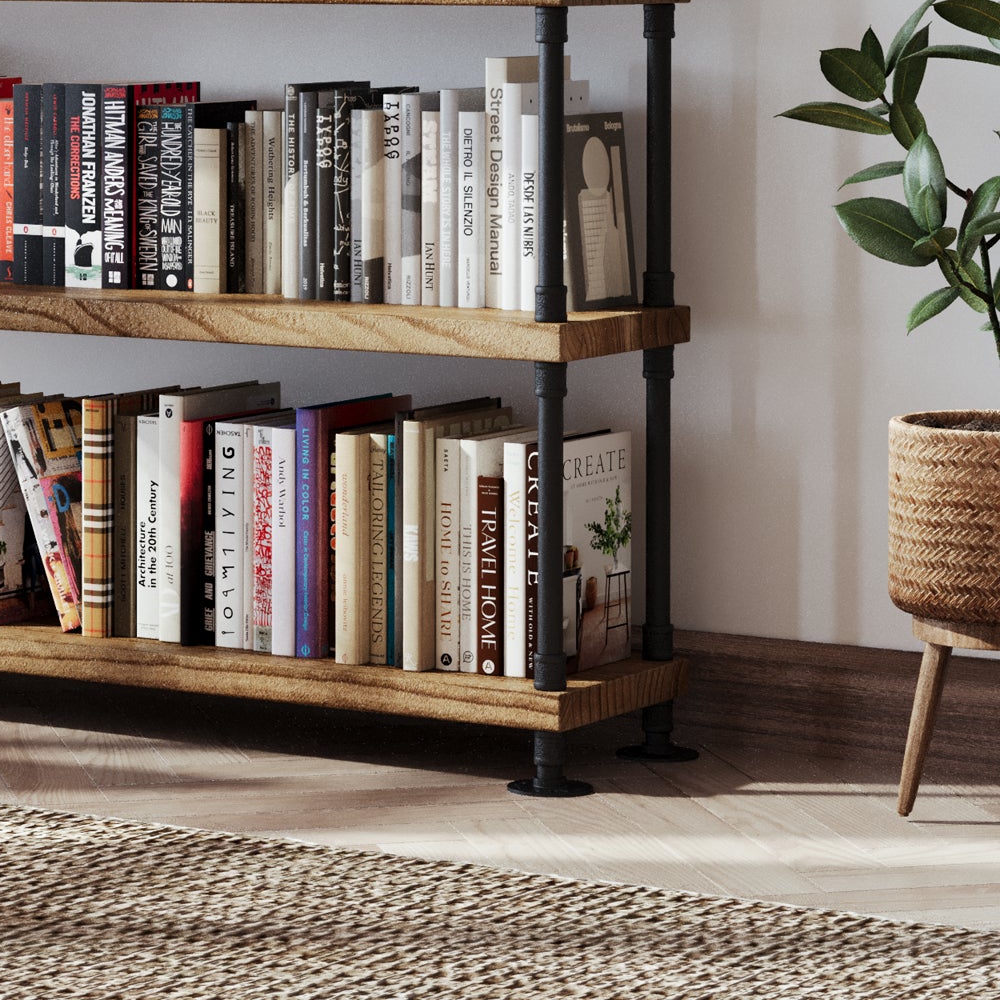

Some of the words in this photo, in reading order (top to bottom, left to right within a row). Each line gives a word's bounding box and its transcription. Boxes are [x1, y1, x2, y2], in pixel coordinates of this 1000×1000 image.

[71, 116, 79, 135] THE
[82, 91, 95, 157] JONATHAN
[104, 100, 124, 148] HITMAN
[490, 88, 503, 142] Street
[463, 128, 472, 167] DIETRO
[71, 137, 80, 200] CORRECTIONS
[105, 151, 124, 195] ANDERS
[139, 156, 157, 189] SAVED
[463, 172, 472, 180] IL
[487, 150, 503, 208] Design
[82, 162, 95, 223] FRANZEN
[139, 199, 158, 223] KING
[463, 185, 472, 236] SILENZIO
[139, 230, 158, 270] SWEDEN
[426, 243, 434, 260] IAN
[490, 215, 503, 275] Manual
[426, 263, 434, 290] HUNT
[278, 457, 286, 485] Andy
[302, 469, 309, 479] IN
[563, 449, 626, 481] CREATE
[149, 480, 158, 523] Century
[278, 490, 286, 528] Warhol
[341, 474, 350, 536] wonderland
[372, 460, 384, 555] TAILORING
[404, 525, 418, 562] KAWS
[440, 501, 451, 554] HOME
[462, 524, 471, 559] THIS
[481, 507, 496, 578] TRAVEL
[205, 530, 214, 575] GRIEVANCE
[440, 560, 451, 575] to
[462, 563, 471, 573] IS
[149, 579, 156, 588] in
[205, 583, 214, 599] AND
[372, 562, 382, 642] LEGENDS
[462, 577, 471, 621] HOME
[205, 608, 214, 631] GRIEF
[440, 581, 451, 642] SHARE
[481, 585, 496, 650] HOME
